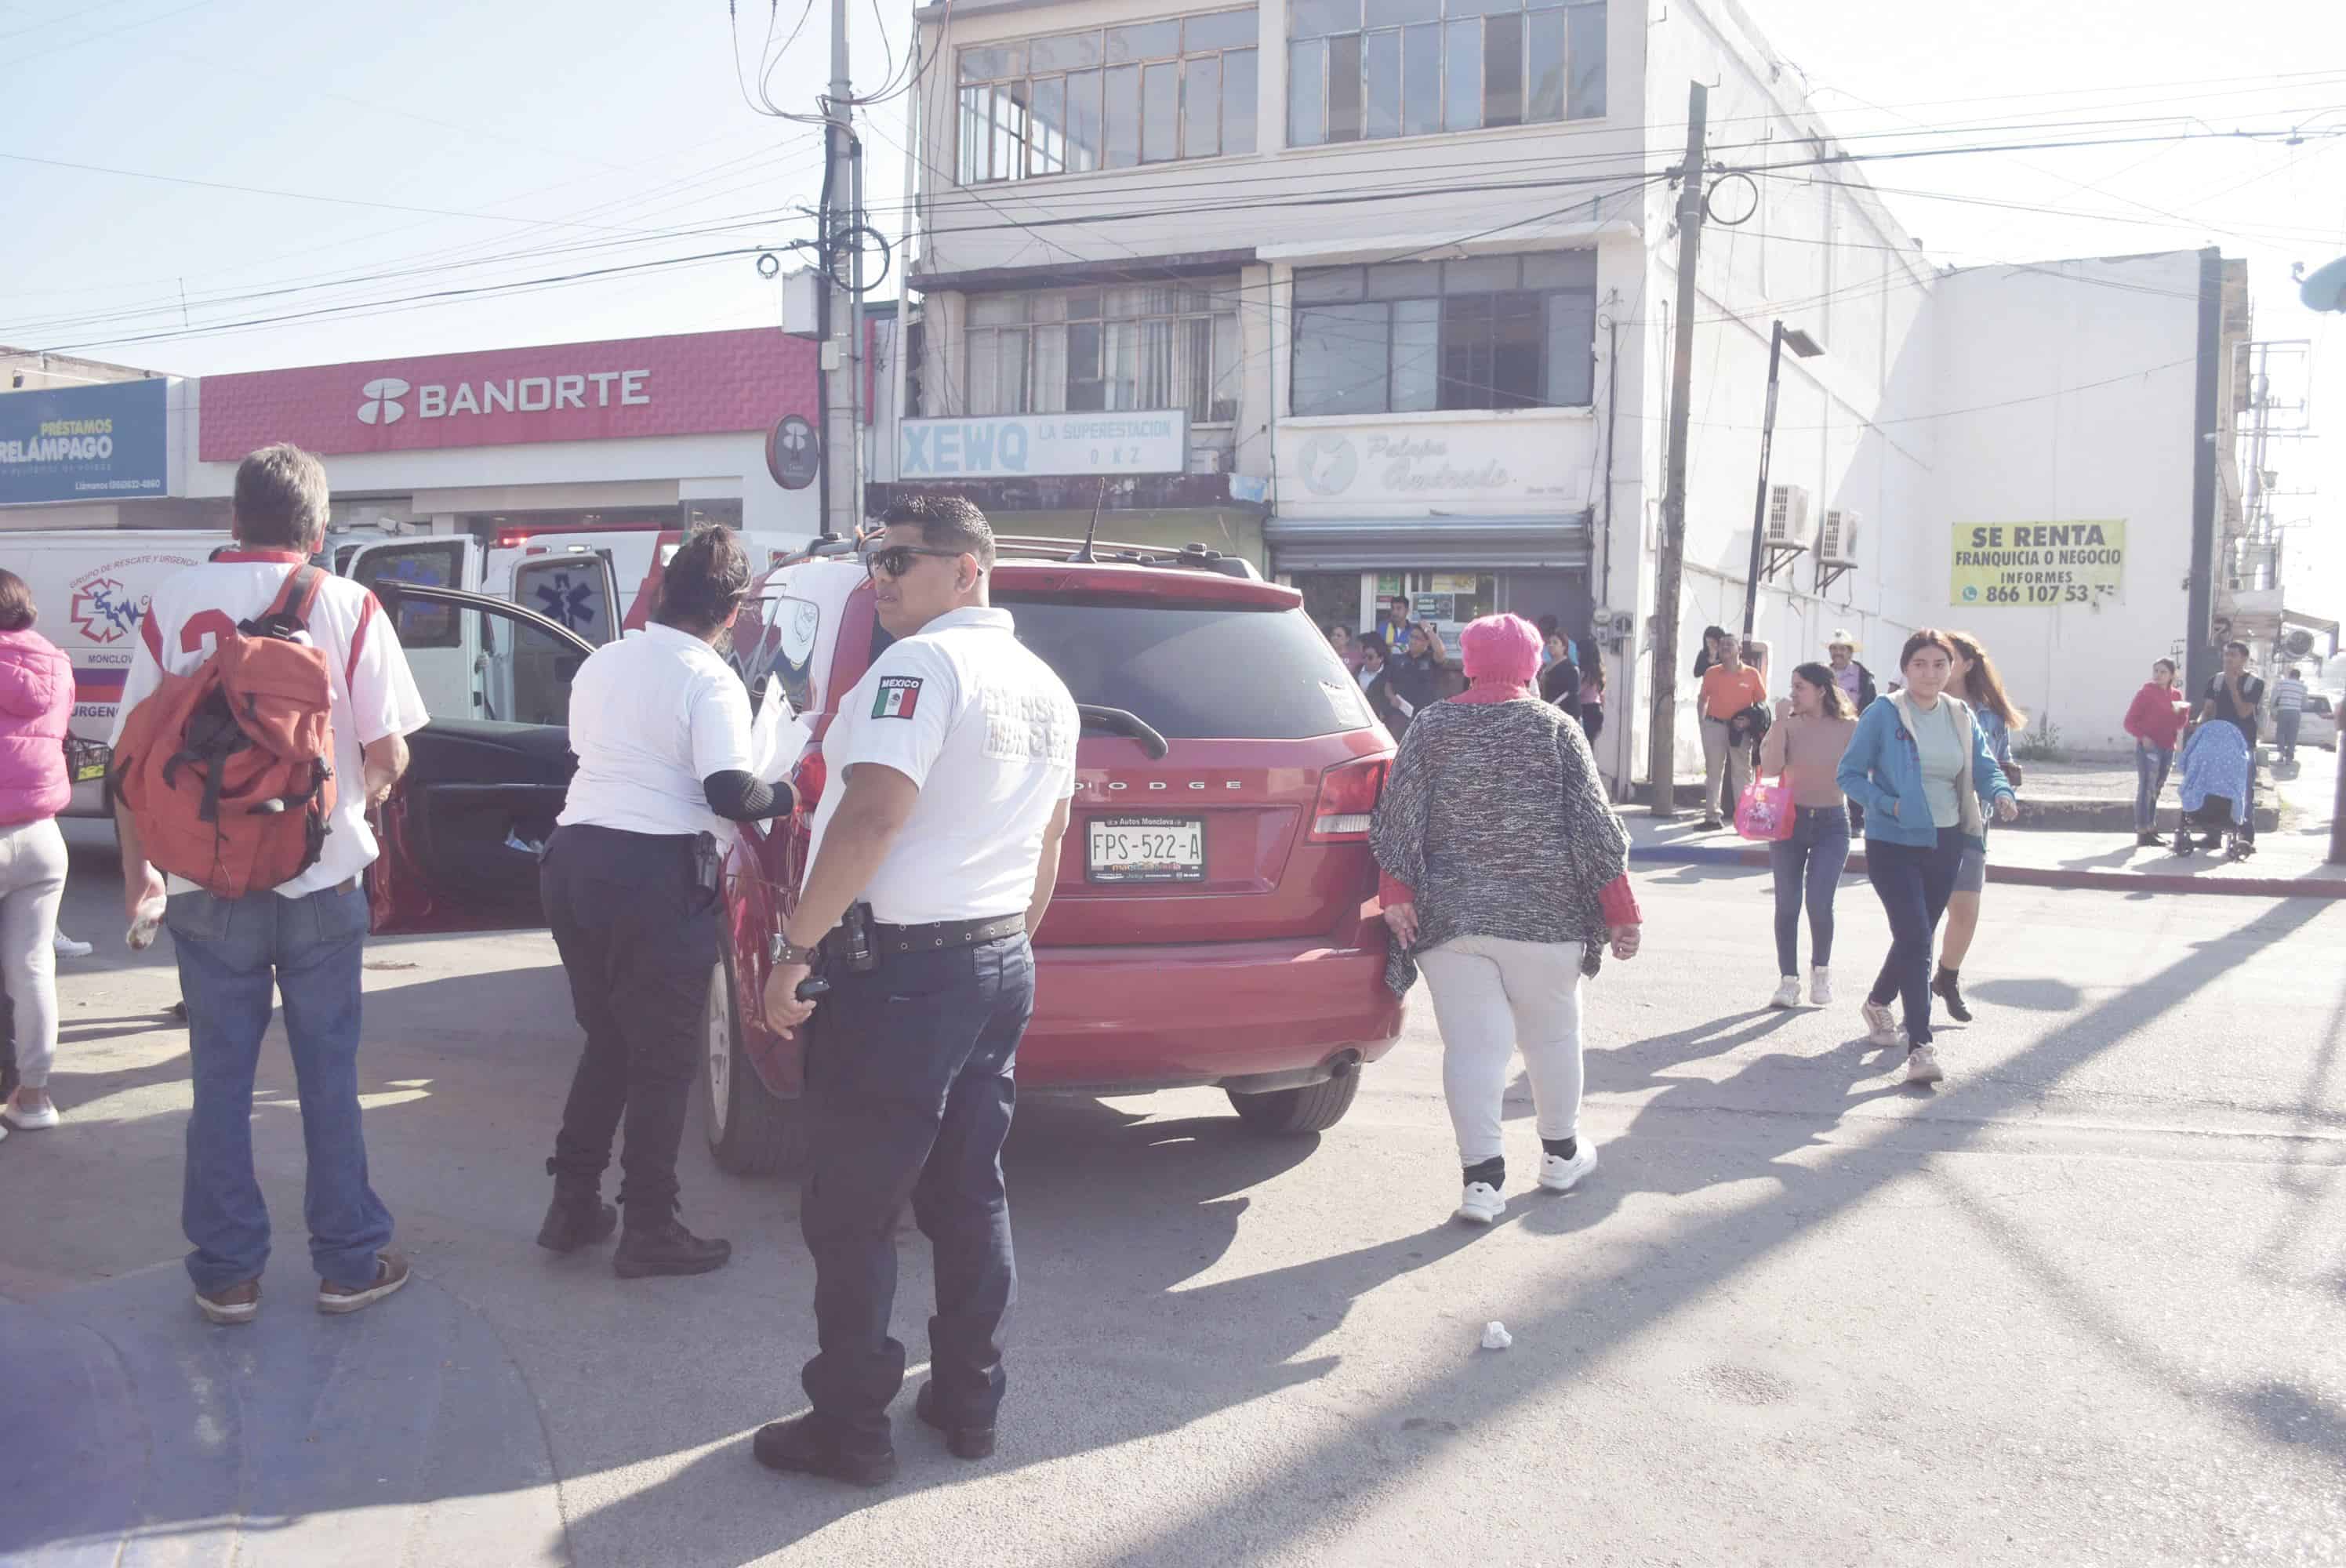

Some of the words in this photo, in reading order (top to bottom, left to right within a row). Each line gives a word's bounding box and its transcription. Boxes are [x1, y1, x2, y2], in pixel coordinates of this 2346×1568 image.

[419, 369, 652, 419] BANORTE
[1040, 423, 1055, 440] LA
[1064, 420, 1171, 440] SUPERESTACION
[0, 434, 113, 463] RELÁMPAGO
[902, 422, 1029, 473] XEWQ
[1971, 526, 2003, 548] SE
[2014, 524, 2106, 547] RENTA
[114, 554, 152, 569] RESCATE
[1955, 550, 2039, 568] FRANQUICIA
[2044, 550, 2054, 565] O
[2059, 550, 2122, 565] NEGOCIO
[2000, 571, 2073, 584] INFORMES
[1986, 586, 2021, 603] 866
[2027, 586, 2060, 602] 107
[2065, 585, 2089, 602] 53
[881, 678, 920, 689] MEXICO
[1093, 833, 1200, 860] FPS-522-A
